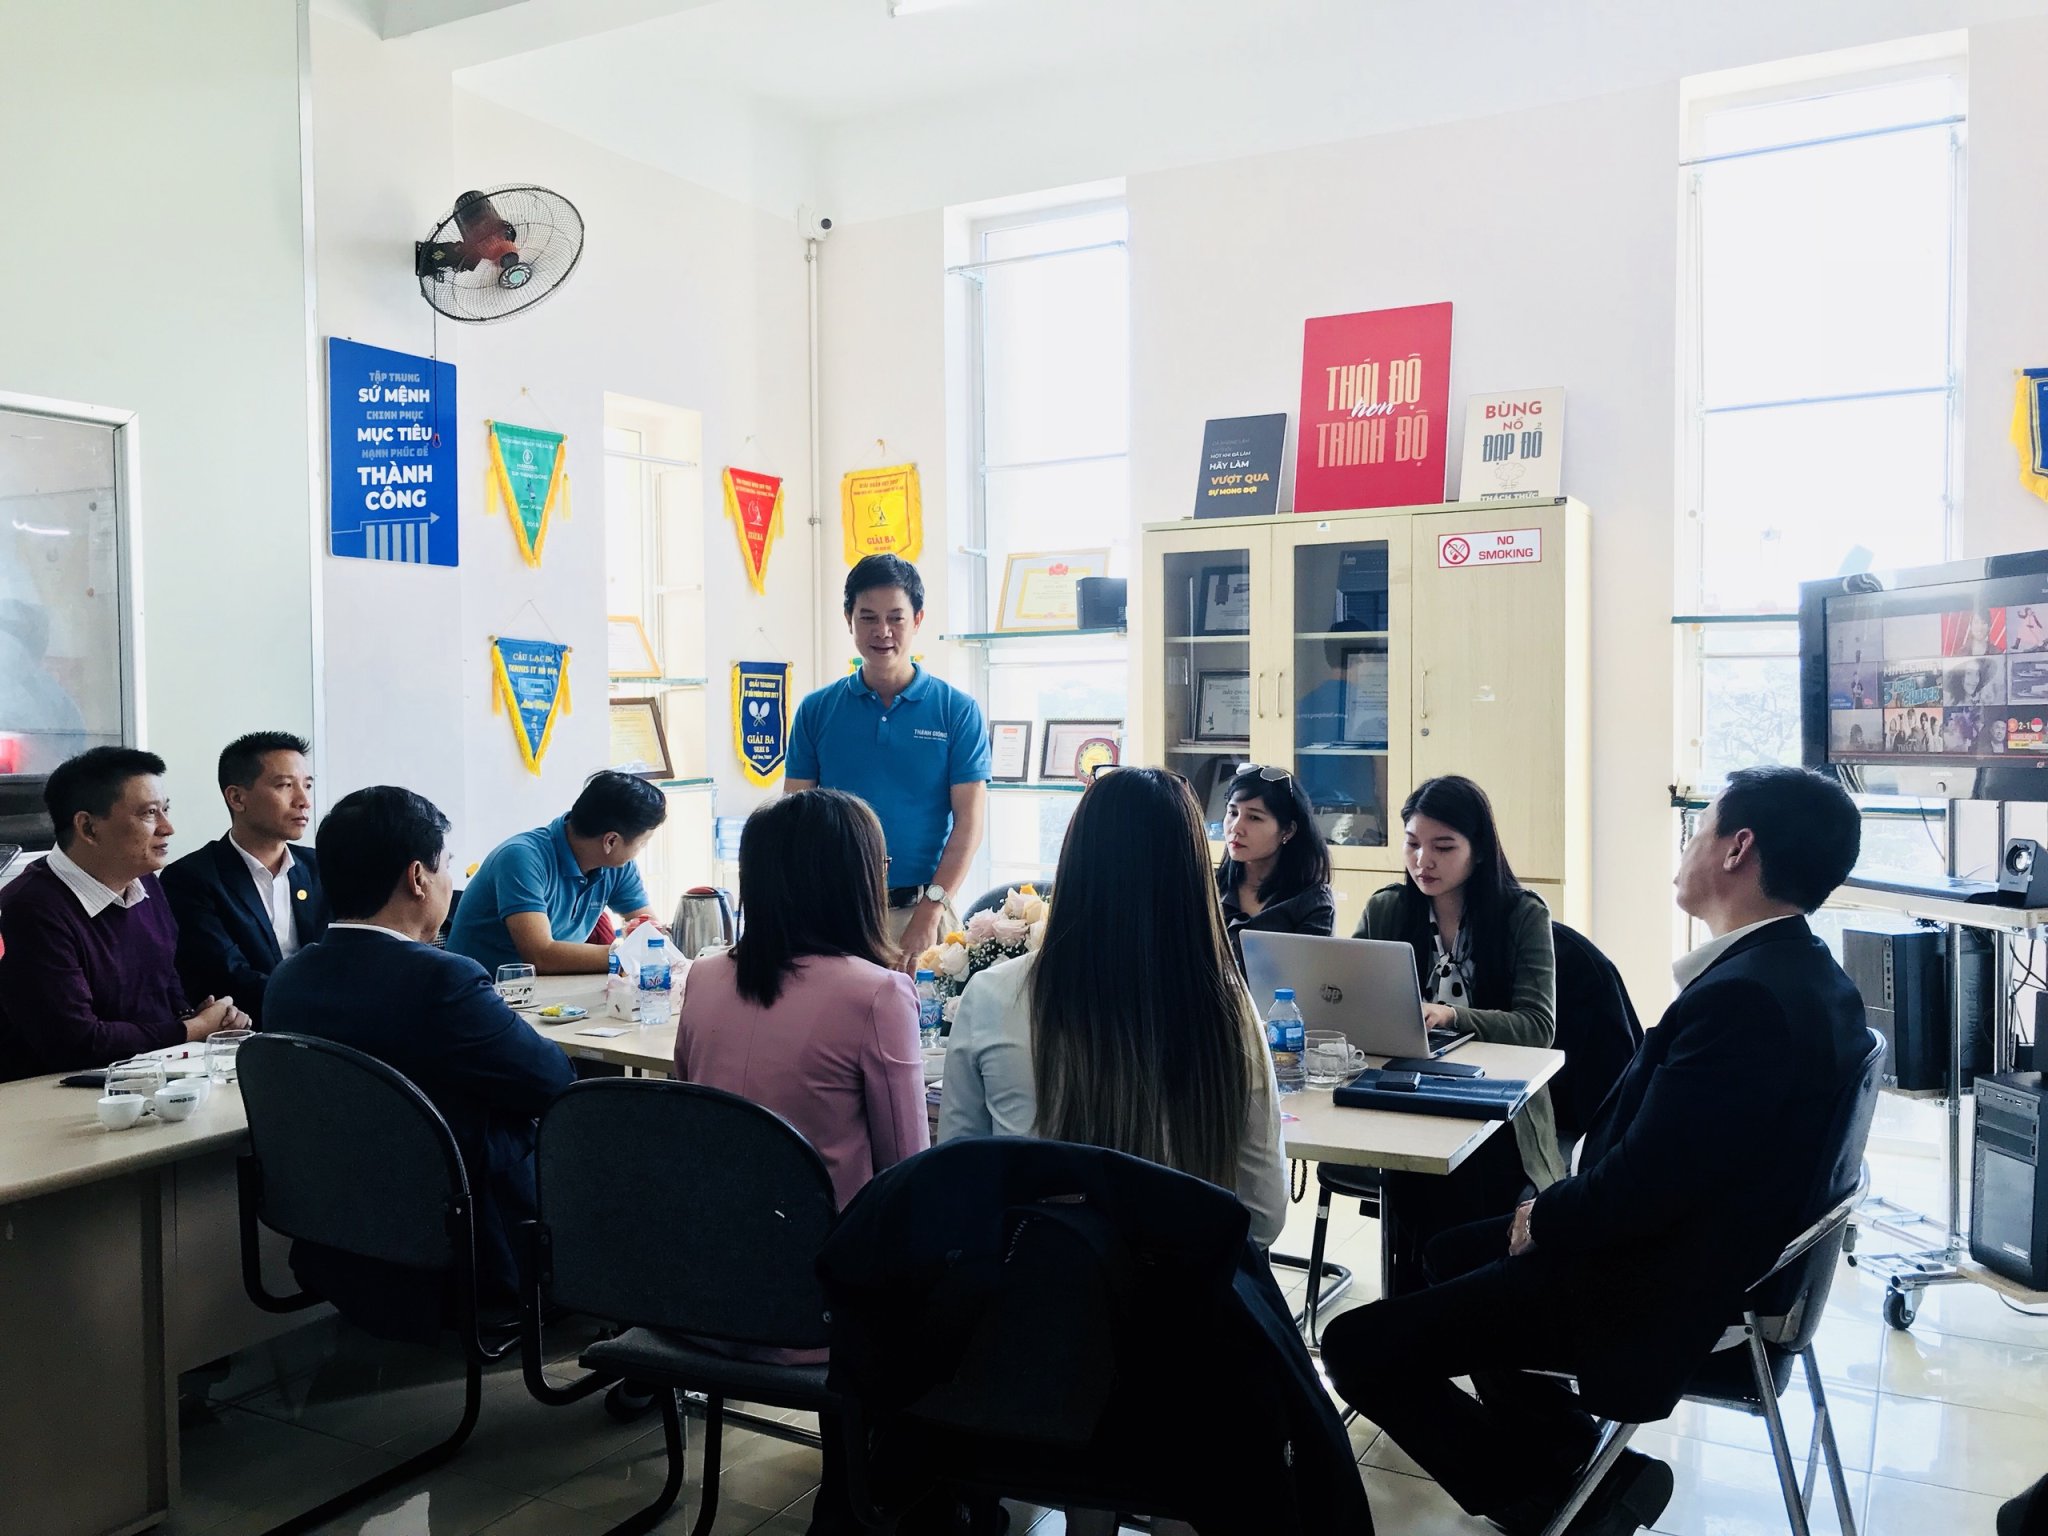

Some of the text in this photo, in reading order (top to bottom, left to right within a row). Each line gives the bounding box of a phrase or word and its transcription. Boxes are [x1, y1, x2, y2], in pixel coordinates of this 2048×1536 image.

[369, 370, 420, 384] TẬP TRUNG
[1388, 353, 1422, 410] ĐỘ
[358, 384, 430, 406] SỨ MỆNH
[366, 410, 424, 422] CHINH PHỤC
[1485, 400, 1542, 419] BÙNG
[357, 423, 433, 445] MỤC TIÊU
[1395, 409, 1429, 466] ĐỘ
[1482, 433, 1515, 465] ĐẠP
[1209, 459, 1249, 470] HÃY LÀM
[357, 461, 433, 485] THÀNH
[1211, 473, 1269, 486] VƯỢT QUA
[365, 486, 426, 511] CÔNG
[1208, 487, 1219, 497] SỰ
[1219, 487, 1242, 495] MONG
[1497, 535, 1514, 545] NO
[1478, 548, 1533, 560] SMOKING
[746, 732, 775, 744] GIẢI BA
